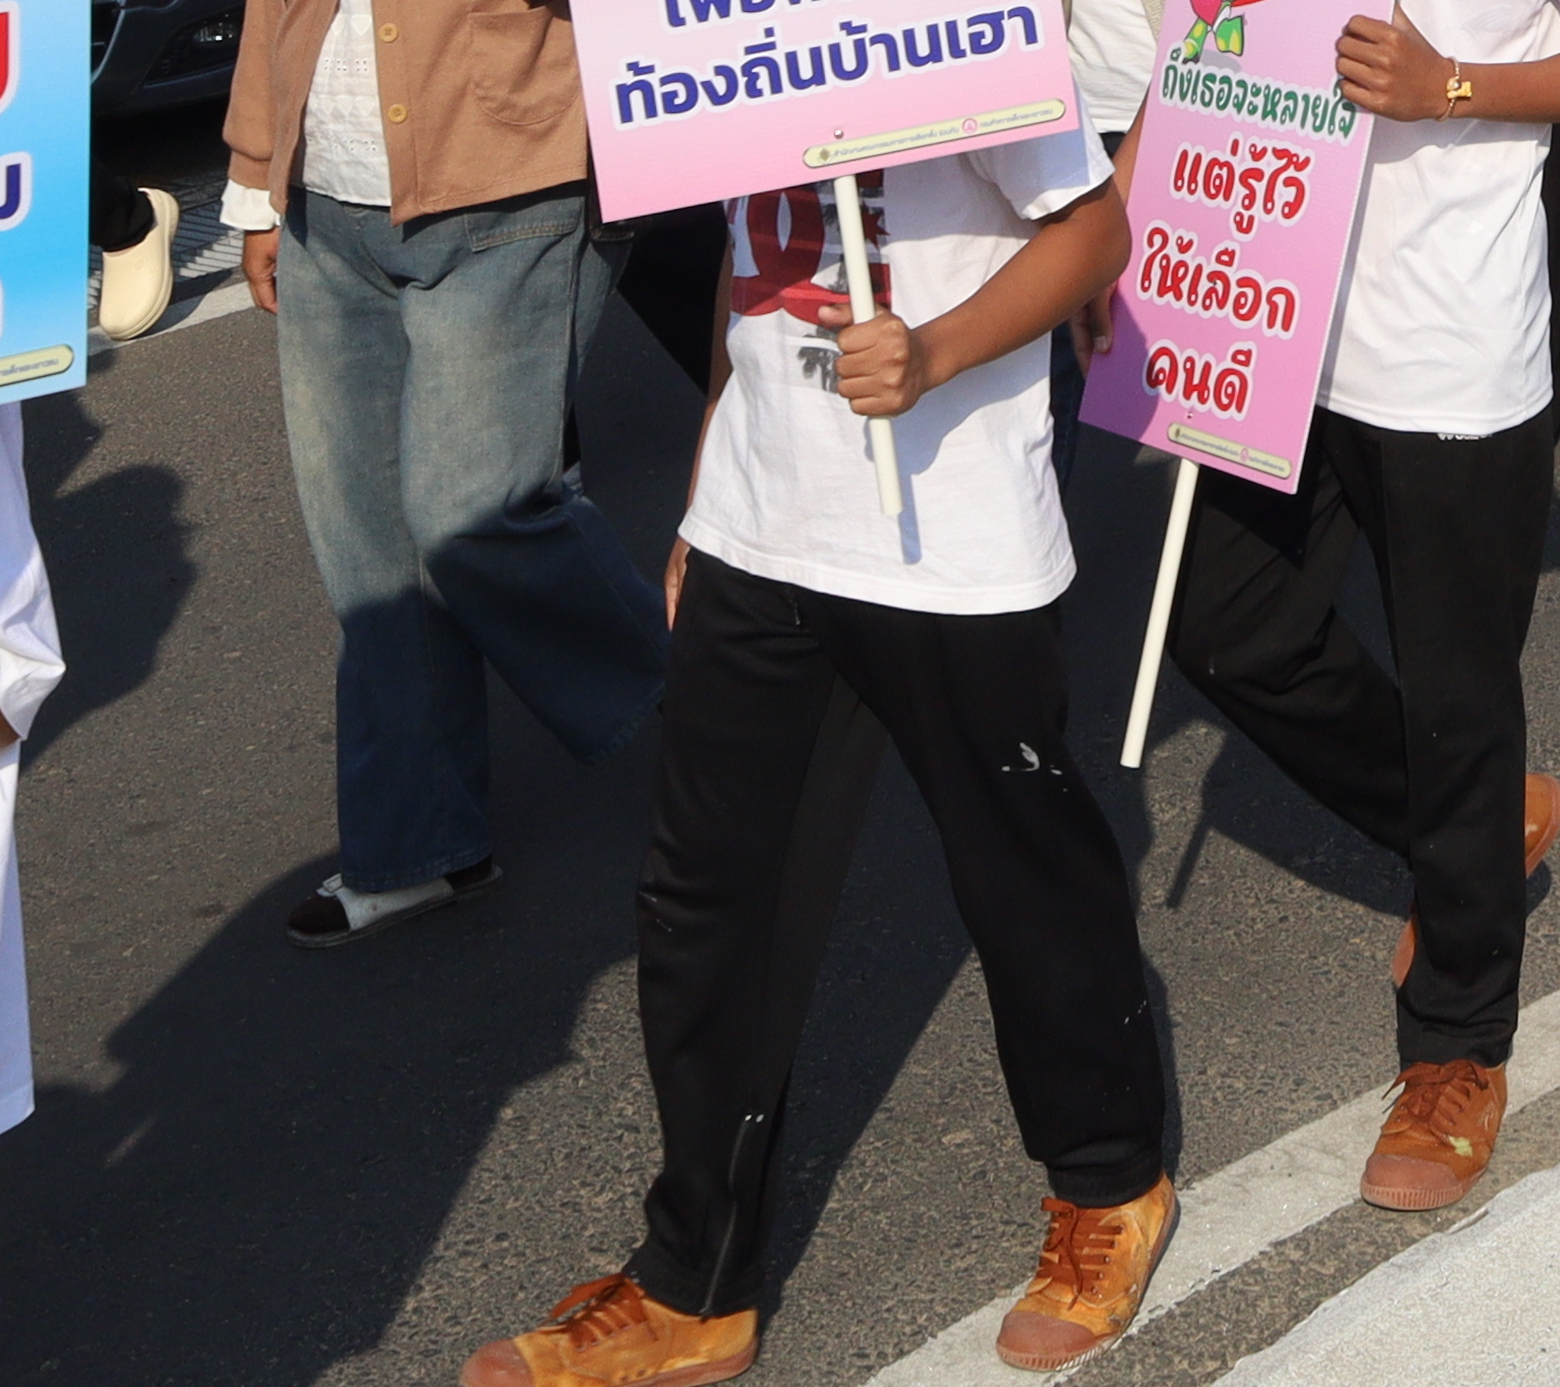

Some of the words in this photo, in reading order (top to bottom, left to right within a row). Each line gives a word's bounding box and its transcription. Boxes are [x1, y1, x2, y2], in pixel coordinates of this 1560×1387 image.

[613, 1, 1040, 126] ท้องถิ่นบ้านเฮา
[1160, 51, 1357, 141] ถึงเธอจะหลายใจ
[1171, 138, 1308, 233] แต่รู้ไว้
[1137, 227, 1297, 335] ให้เลือก
[1143, 344, 1250, 414] คนดี
